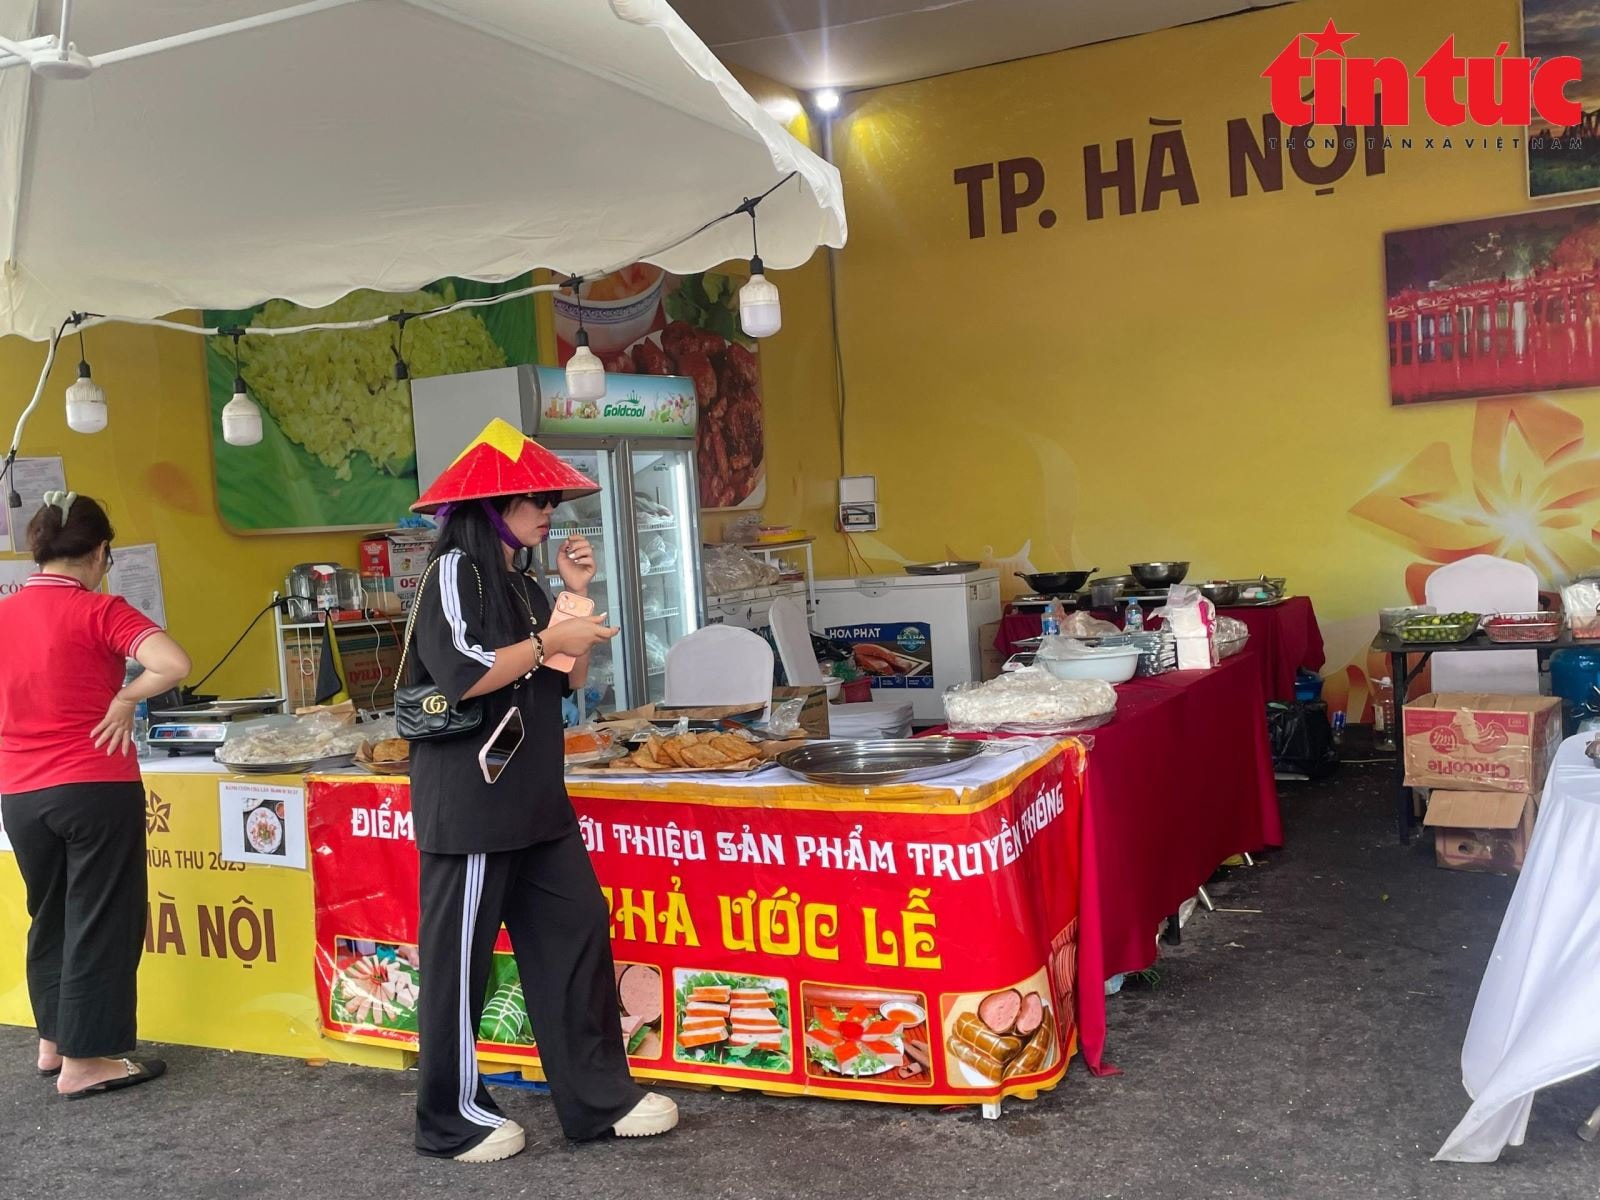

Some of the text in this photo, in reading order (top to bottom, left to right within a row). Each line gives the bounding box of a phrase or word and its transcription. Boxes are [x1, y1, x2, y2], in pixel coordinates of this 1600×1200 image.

[954, 157, 1057, 239] TP.
[1083, 117, 1200, 220] HÀ
[604, 404, 646, 417] Goldcool
[175, 850, 204, 869] THU
[350, 781, 1065, 881] ĐIỂM ỚI THIỆU SẢN PHẨM TRUYỀN THỐNG
[197, 895, 277, 969] NỘI
[717, 886, 840, 961] ƯỚC
[861, 887, 943, 970] LỄ
